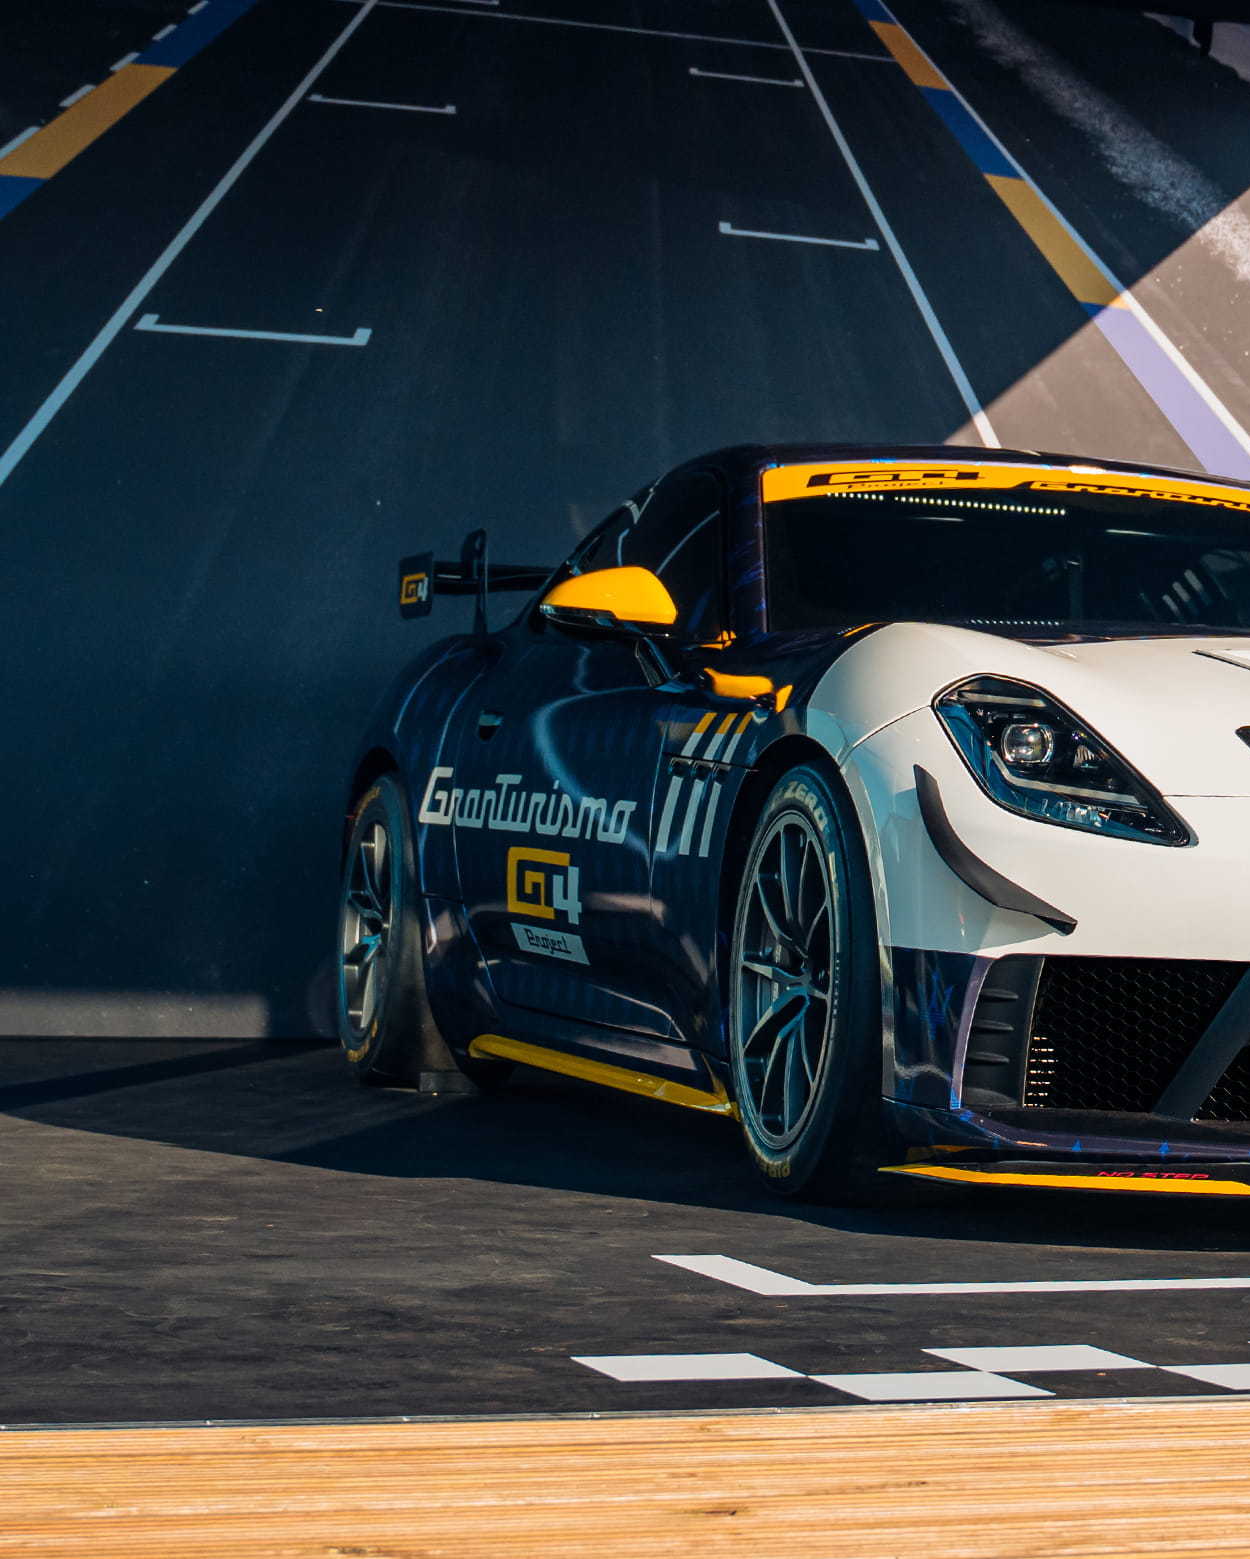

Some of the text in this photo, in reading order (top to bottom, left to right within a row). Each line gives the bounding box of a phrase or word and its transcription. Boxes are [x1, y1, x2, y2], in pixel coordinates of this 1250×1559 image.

[418, 766, 638, 845] GranTurismo
[783, 781, 829, 832] ZERO
[1141, 1172, 1210, 1180] STEP
